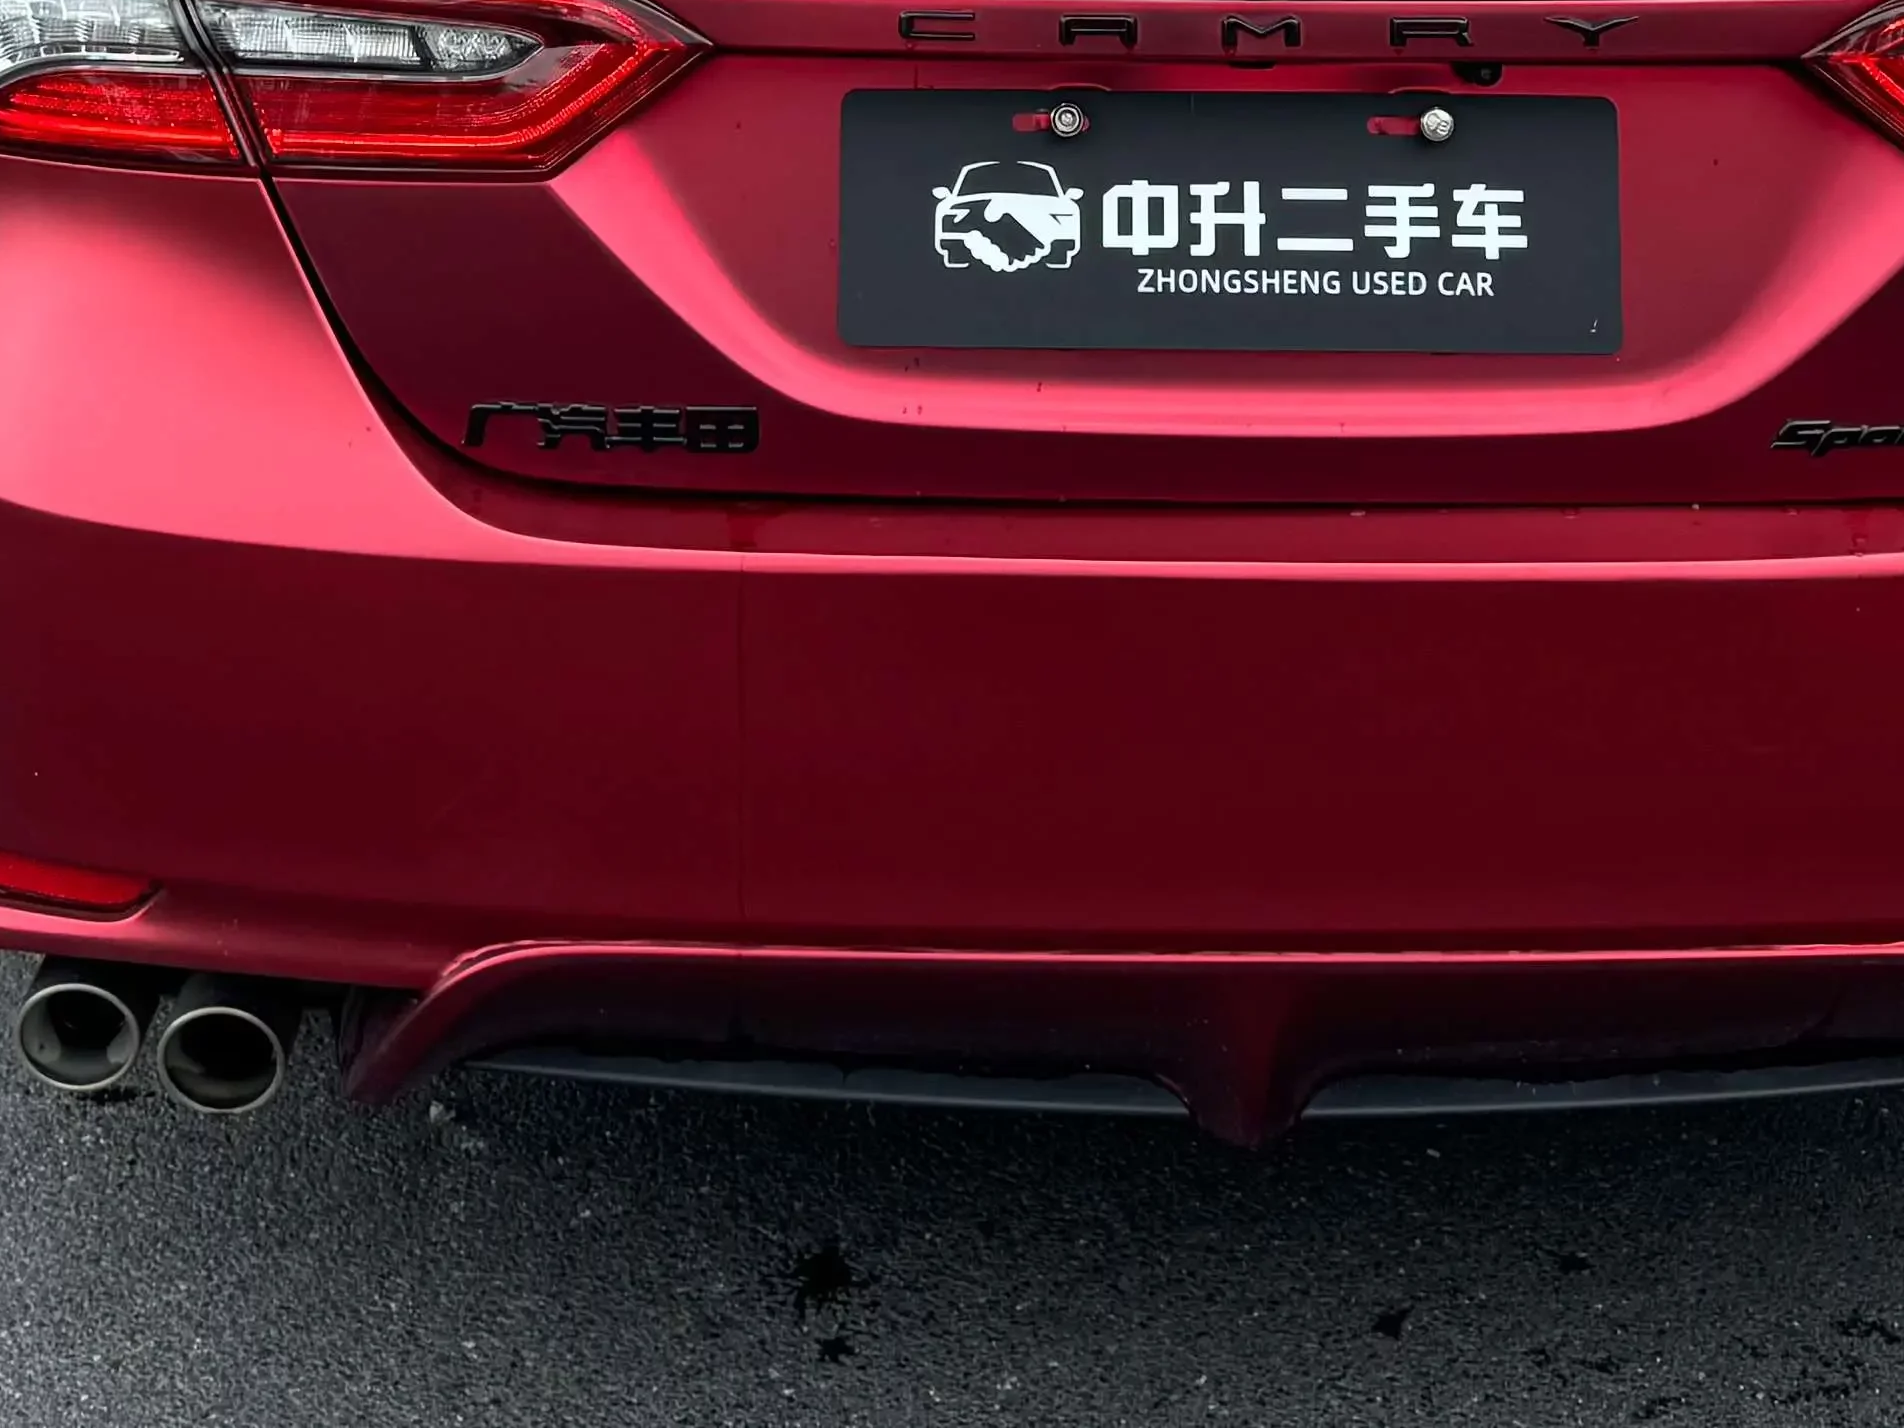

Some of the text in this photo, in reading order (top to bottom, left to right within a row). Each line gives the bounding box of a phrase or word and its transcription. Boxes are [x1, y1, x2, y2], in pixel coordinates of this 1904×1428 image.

[898, 10, 1639, 48] CAMRY
[1101, 178, 1530, 262] 中升二手车
[1137, 268, 1495, 297] ZHONGSHENG USED CAR
[461, 401, 761, 454] 广汽丰田
